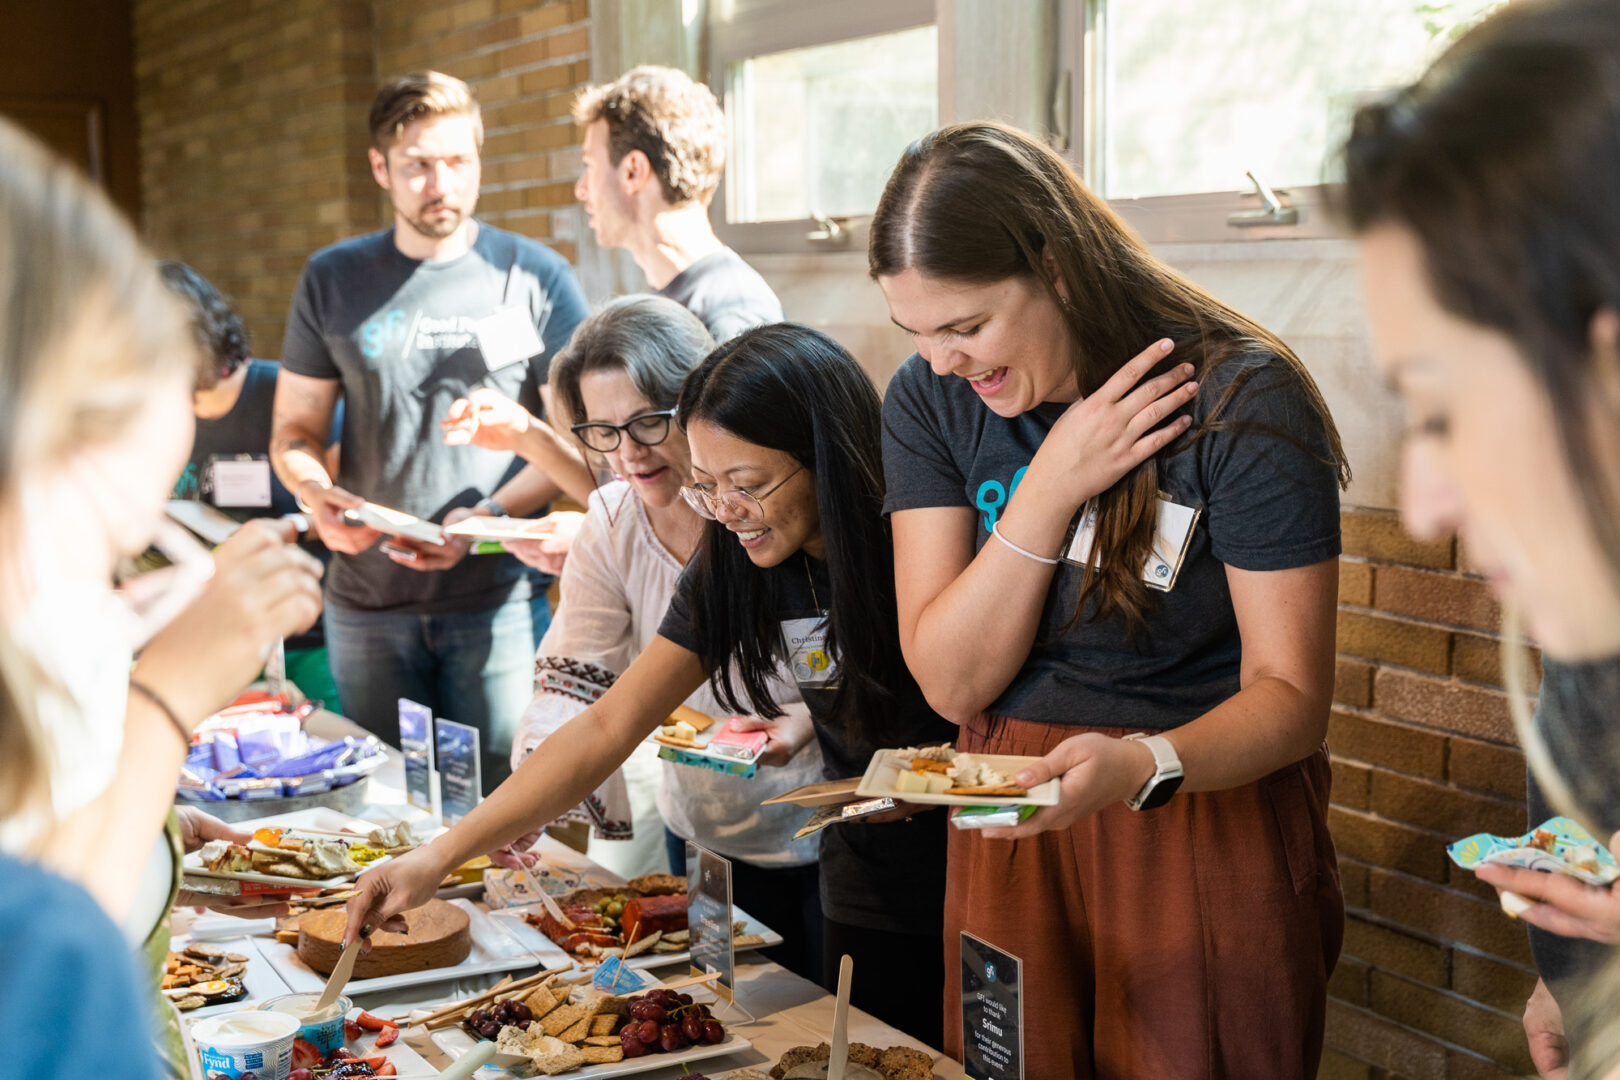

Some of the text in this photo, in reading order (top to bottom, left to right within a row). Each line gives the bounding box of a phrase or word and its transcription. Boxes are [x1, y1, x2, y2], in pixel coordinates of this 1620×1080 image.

[985, 998, 999, 1009] would
[988, 1007, 1001, 1020] thank
[982, 1018, 1003, 1037] Srimu
[204, 1054, 230, 1068] Fynd
